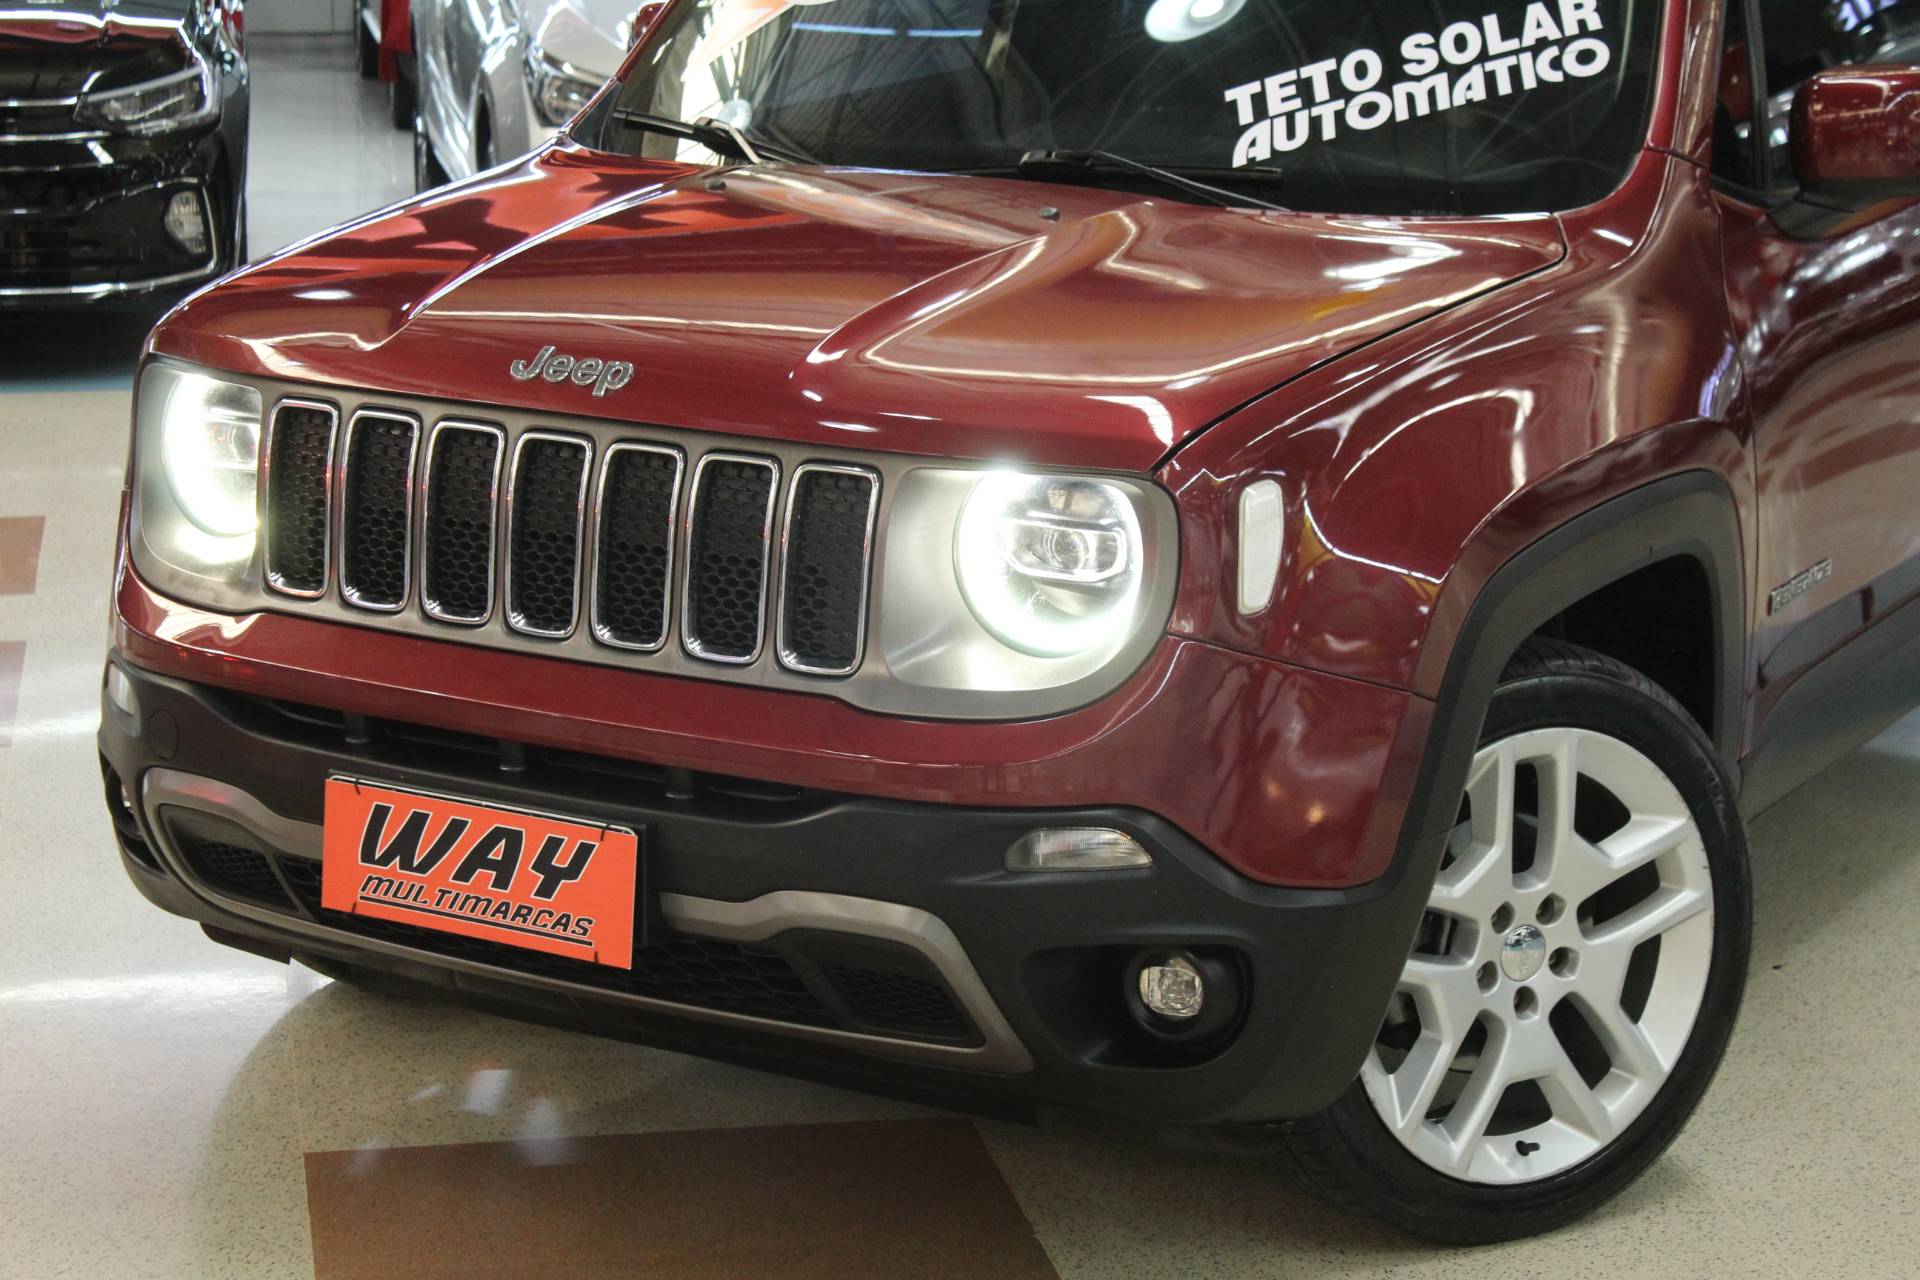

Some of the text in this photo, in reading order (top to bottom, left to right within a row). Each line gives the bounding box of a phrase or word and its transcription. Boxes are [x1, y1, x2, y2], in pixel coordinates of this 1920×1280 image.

[1224, 0, 1604, 126] TETO SOLAR
[1232, 37, 1610, 168] AUTOMATICO
[510, 345, 634, 397] Jeep
[359, 802, 599, 901] WAY
[360, 874, 595, 938] MULTIMARCAS
